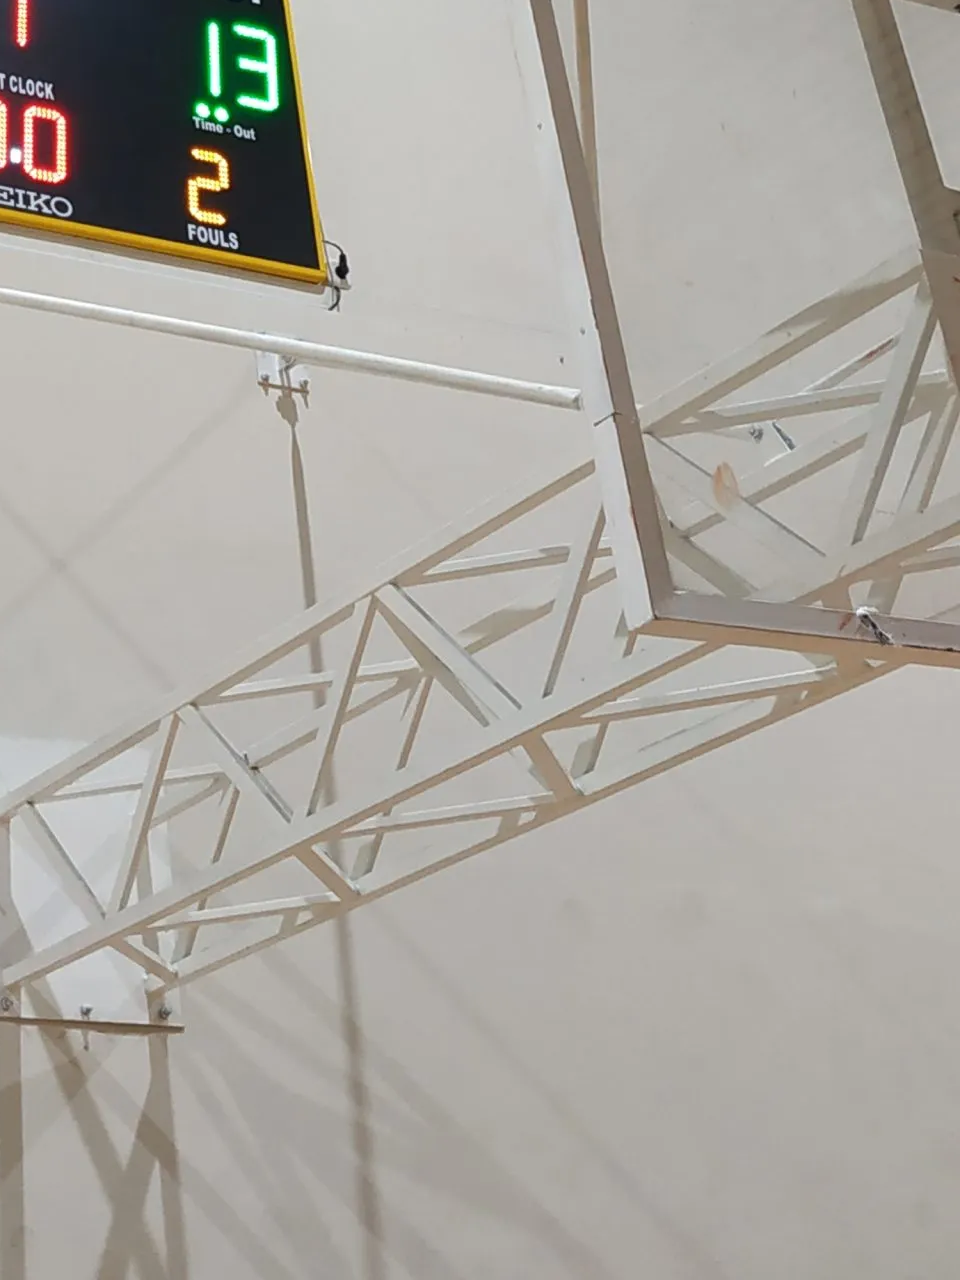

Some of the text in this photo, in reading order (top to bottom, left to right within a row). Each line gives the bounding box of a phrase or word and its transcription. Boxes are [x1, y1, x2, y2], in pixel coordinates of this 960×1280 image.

[208, 21, 280, 112] 13
[9, 74, 55, 100] CLOCK
[192, 116, 224, 134] Time
[233, 124, 256, 141] Out
[188, 147, 229, 225] 2
[187, 224, 239, 250] FOULS
